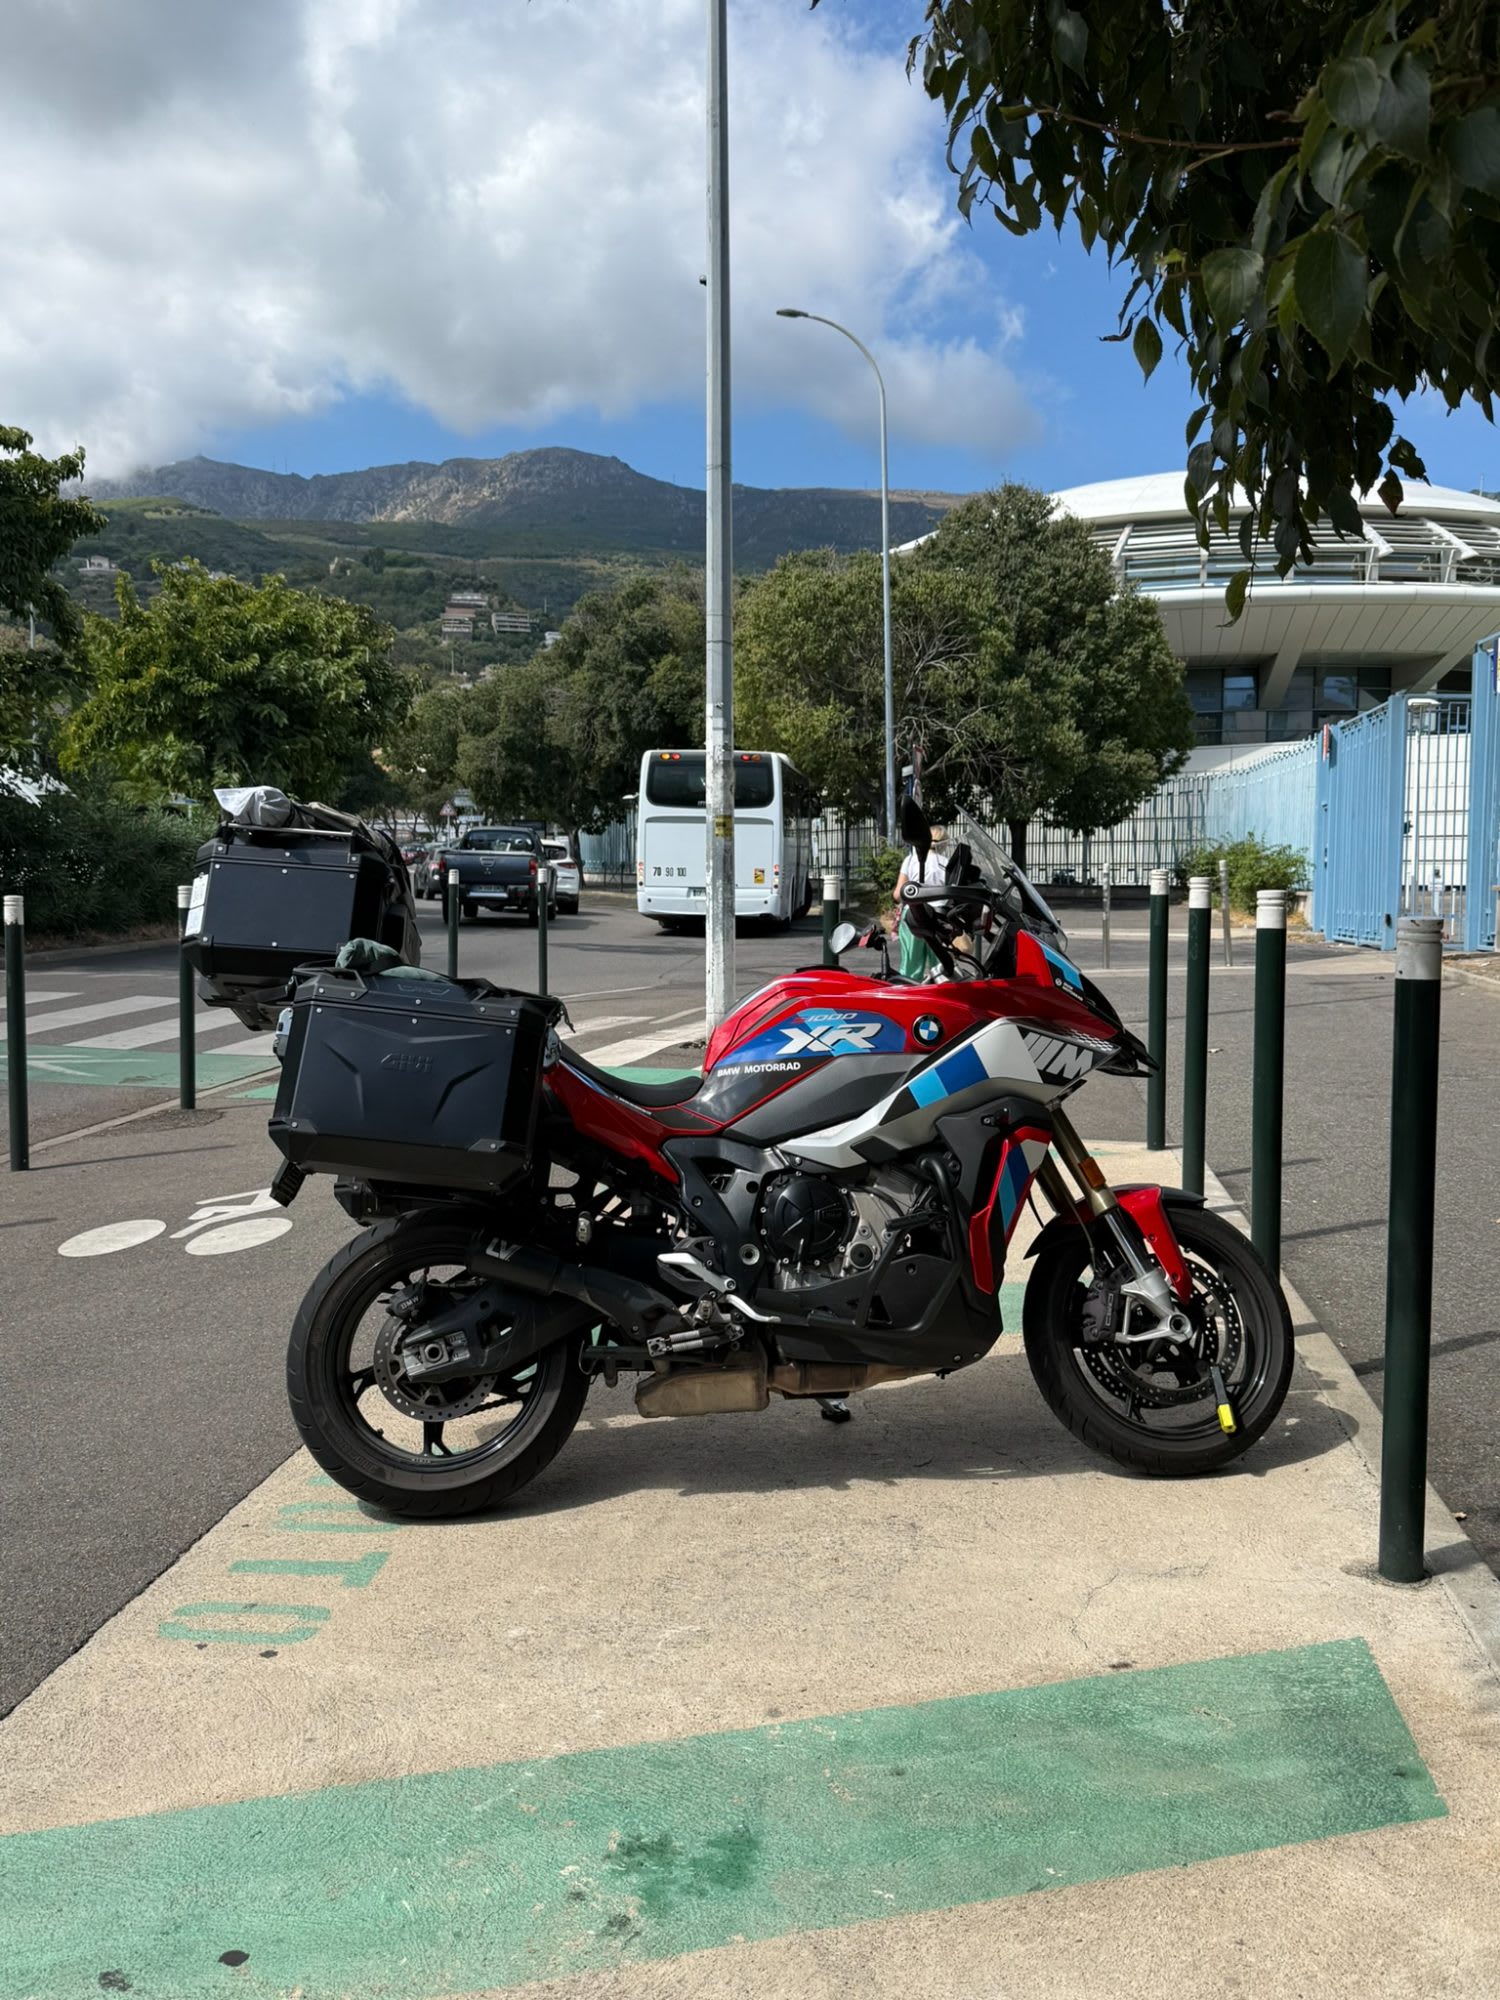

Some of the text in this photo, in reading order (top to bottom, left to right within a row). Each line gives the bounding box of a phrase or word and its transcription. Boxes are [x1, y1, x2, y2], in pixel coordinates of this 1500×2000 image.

[665, 866, 674, 877] 90
[677, 867, 687, 877] 100
[808, 1012, 858, 1022] 1000
[775, 1022, 882, 1054] XR
[717, 1062, 801, 1077] BMW MOTORRAD
